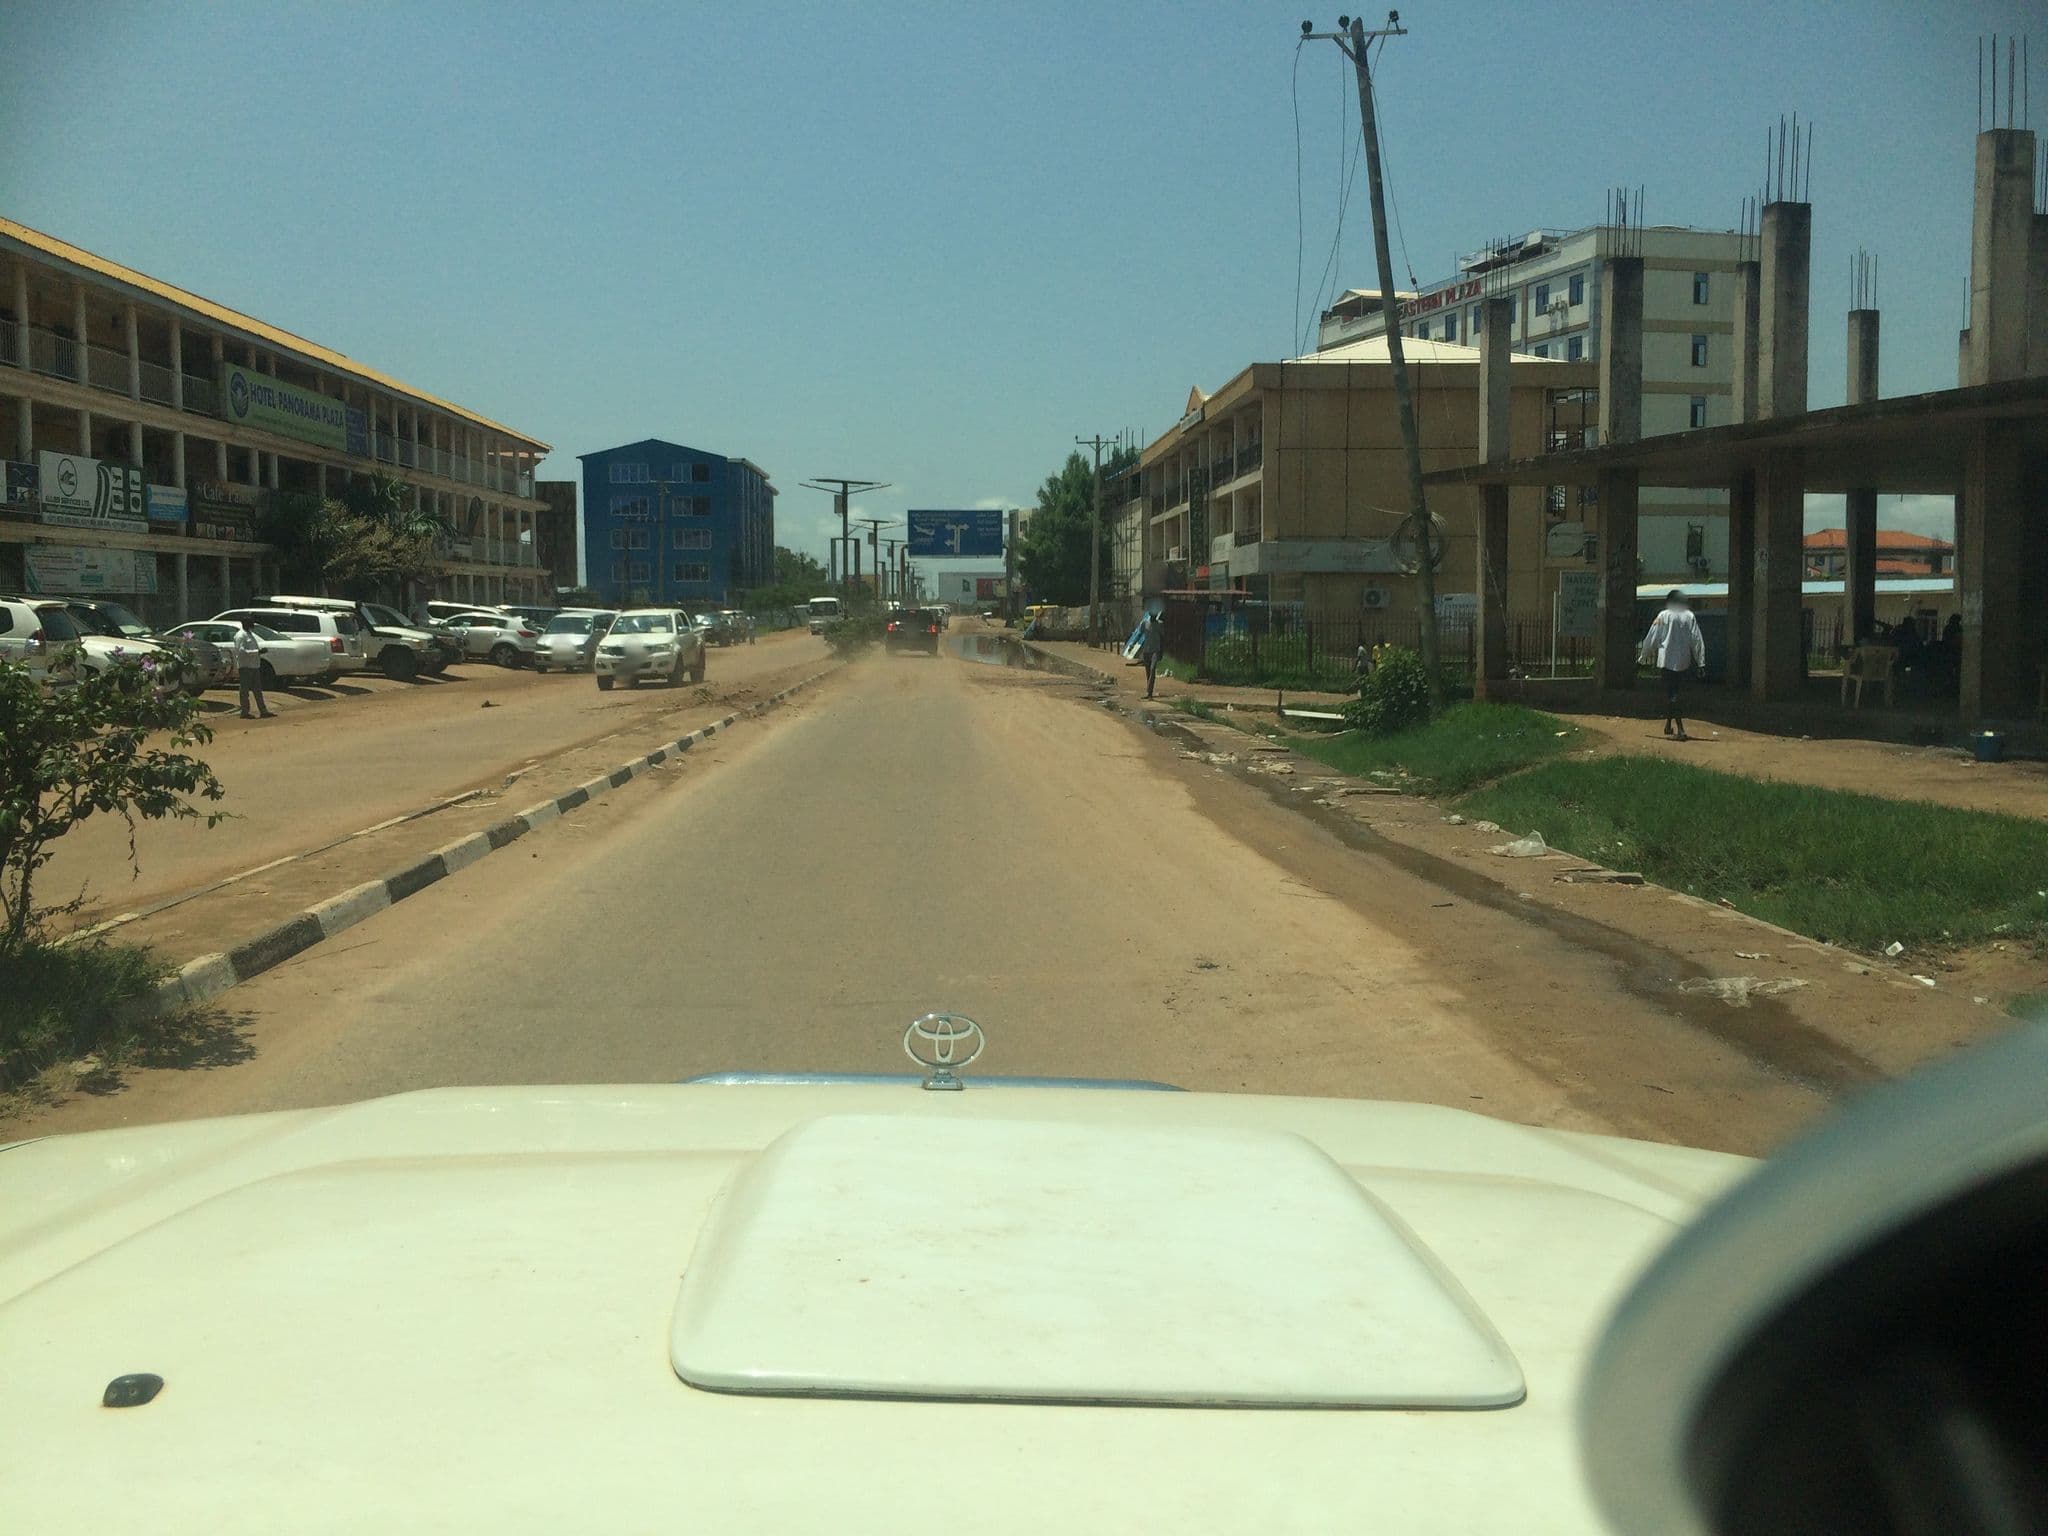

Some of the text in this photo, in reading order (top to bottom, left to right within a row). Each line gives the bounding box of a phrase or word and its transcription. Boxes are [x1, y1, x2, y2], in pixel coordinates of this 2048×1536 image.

[1446, 279, 1481, 305] PLAZA
[250, 382, 277, 409] HOTEL
[278, 391, 322, 422] PANORAMA
[322, 405, 345, 428] PLAZA
